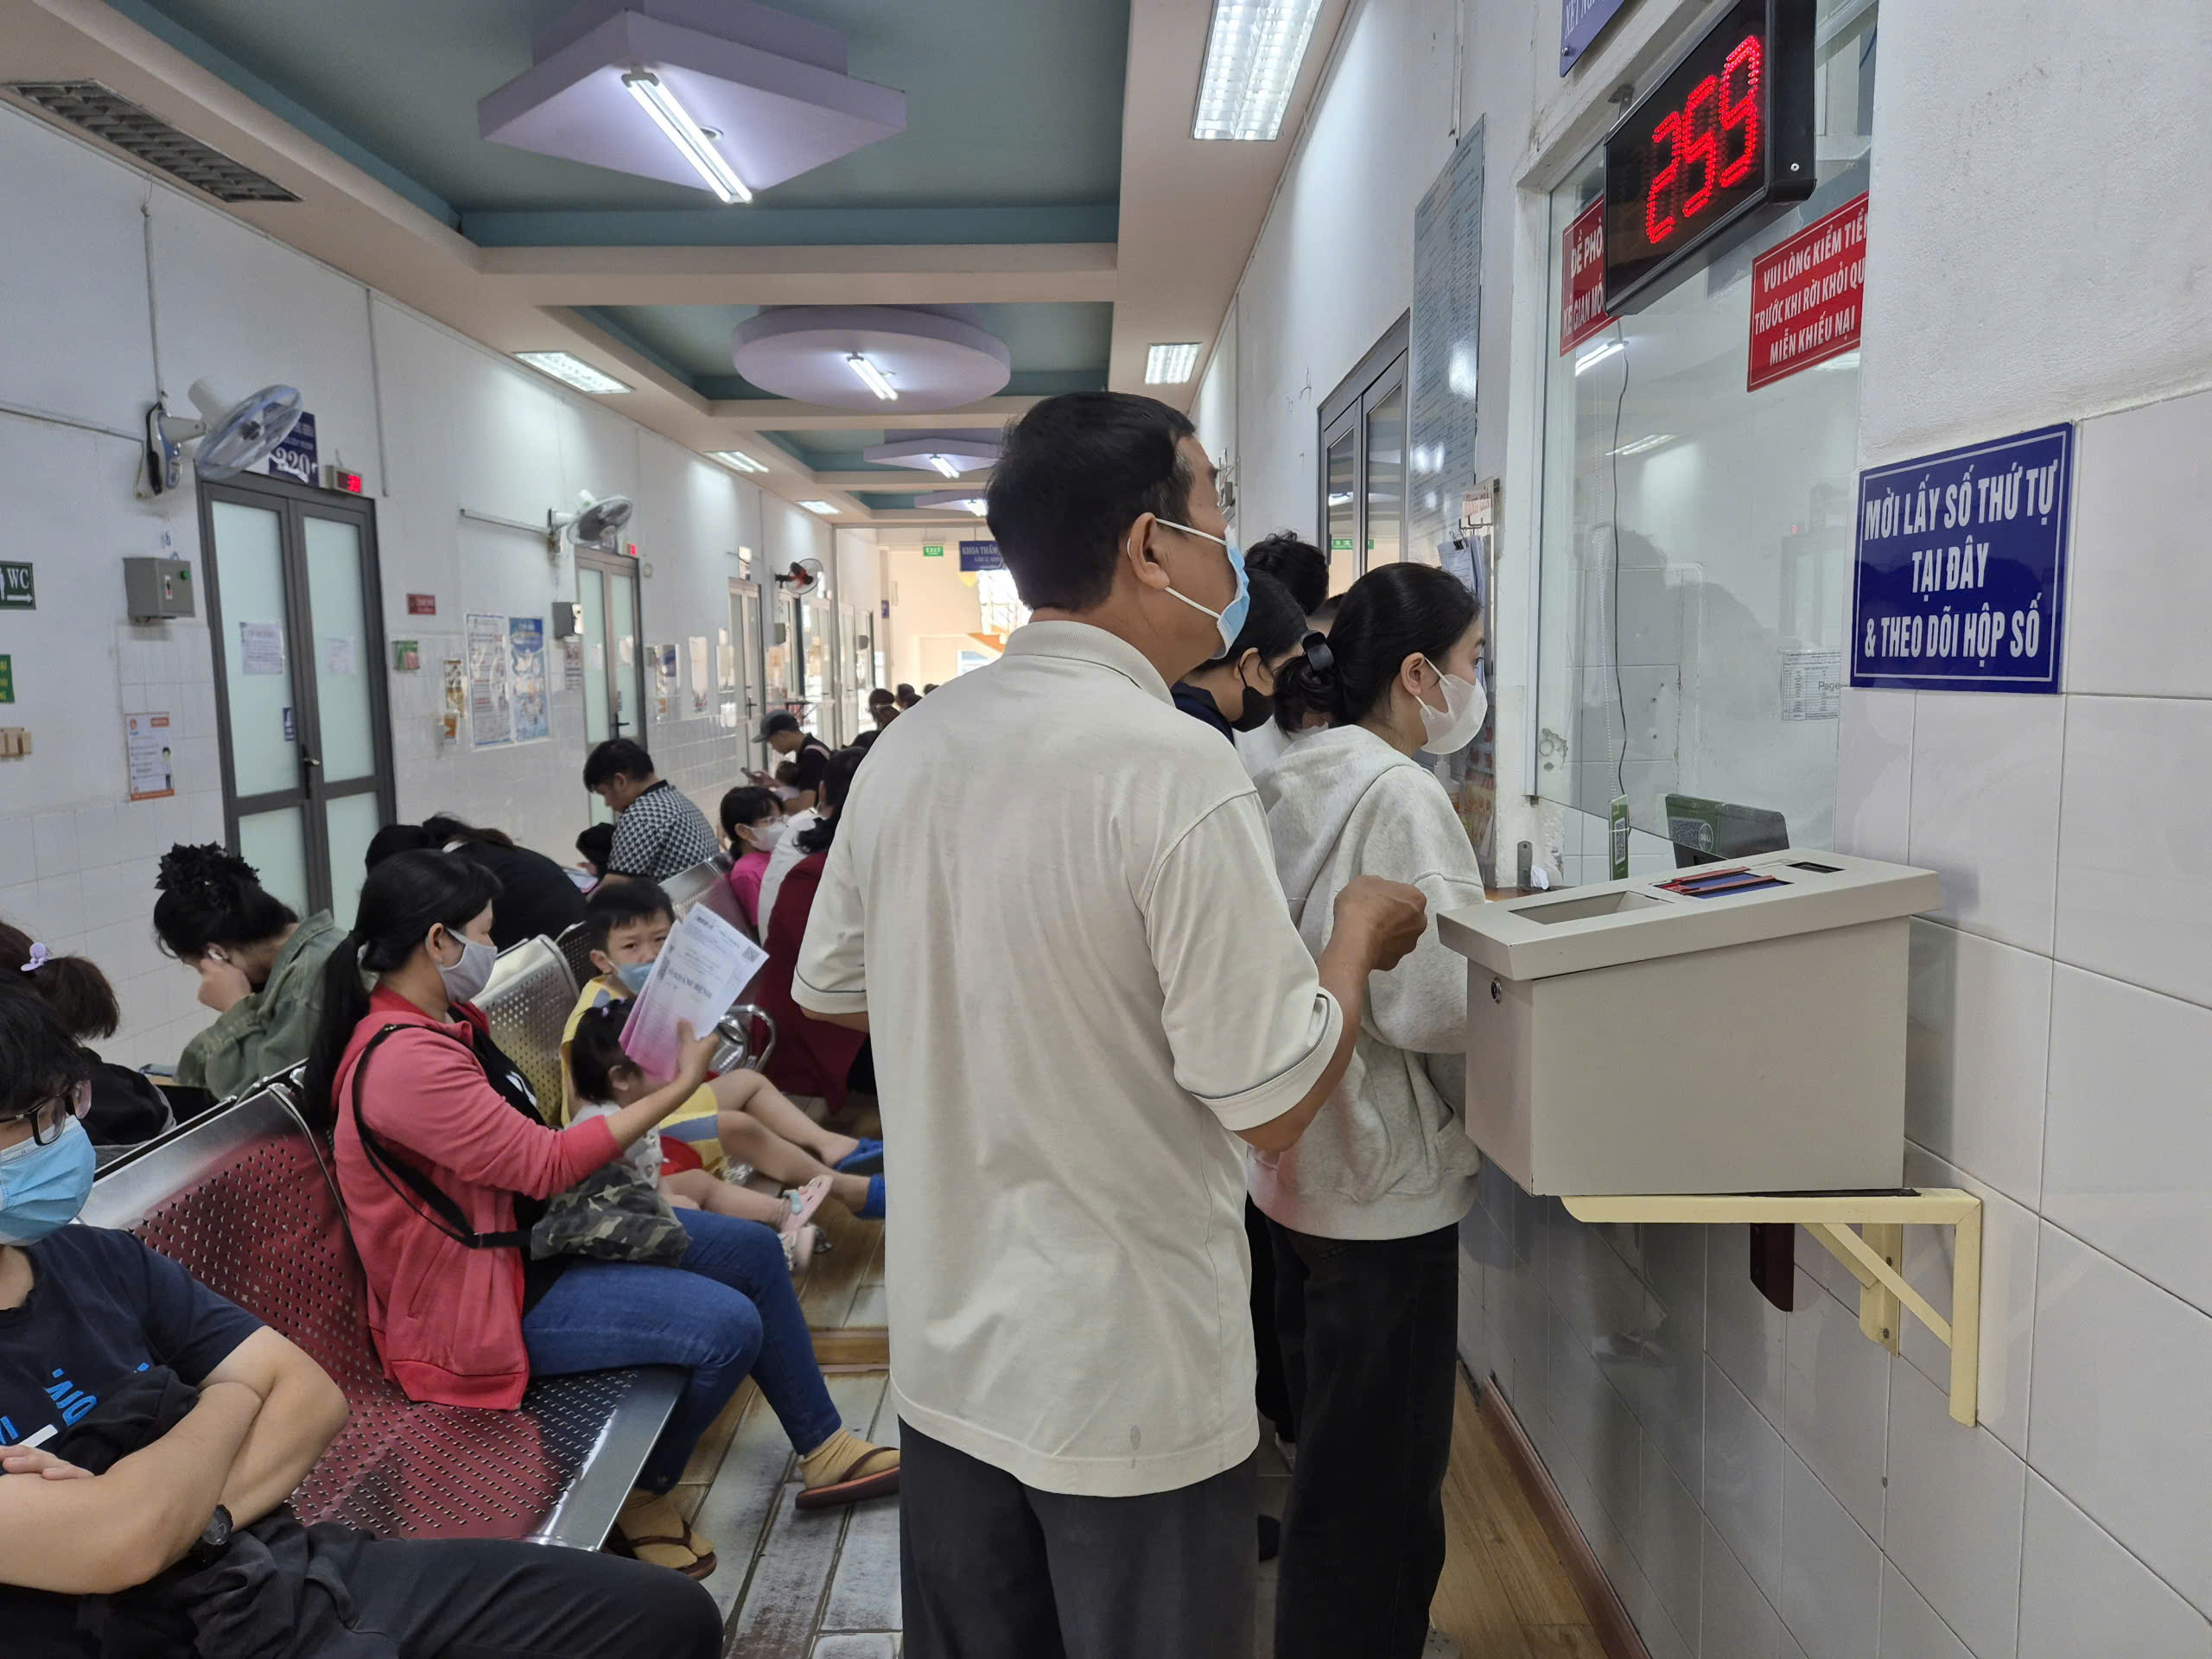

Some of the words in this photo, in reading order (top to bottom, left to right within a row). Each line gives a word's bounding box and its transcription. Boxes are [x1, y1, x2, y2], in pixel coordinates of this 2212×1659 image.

[1645, 35, 1762, 244] 259
[1584, 217, 1604, 269] PHÒ
[1764, 263, 1782, 293] VUI
[1783, 245, 1811, 283] LÒNG
[1813, 224, 1842, 266] KIỂM
[1573, 292, 1591, 330] GIAN
[1755, 298, 1784, 335] TRƯỚC
[1784, 290, 1802, 321] KHI
[1803, 278, 1821, 312] RỜI
[1821, 261, 1848, 302] KHỎI
[1770, 327, 1796, 366] MIỄN
[1798, 311, 1833, 353] KHIẾU
[1834, 304, 1856, 340] NẠI
[1864, 486, 1900, 541] MỜI
[1904, 474, 1941, 535] LẤY
[1943, 464, 1974, 529] SỐ
[1978, 461, 2023, 524] THỨ
[2026, 459, 2058, 525] TỰ
[7, 568, 29, 589] WC
[1911, 548, 1942, 602] TẠI
[1946, 534, 1990, 591] ĐÂY
[1864, 618, 1876, 658] &
[1880, 615, 1923, 658] THEO
[1926, 605, 1960, 658] DÕI
[1962, 601, 2005, 668] HỘP
[2010, 592, 2043, 658] SỐ
